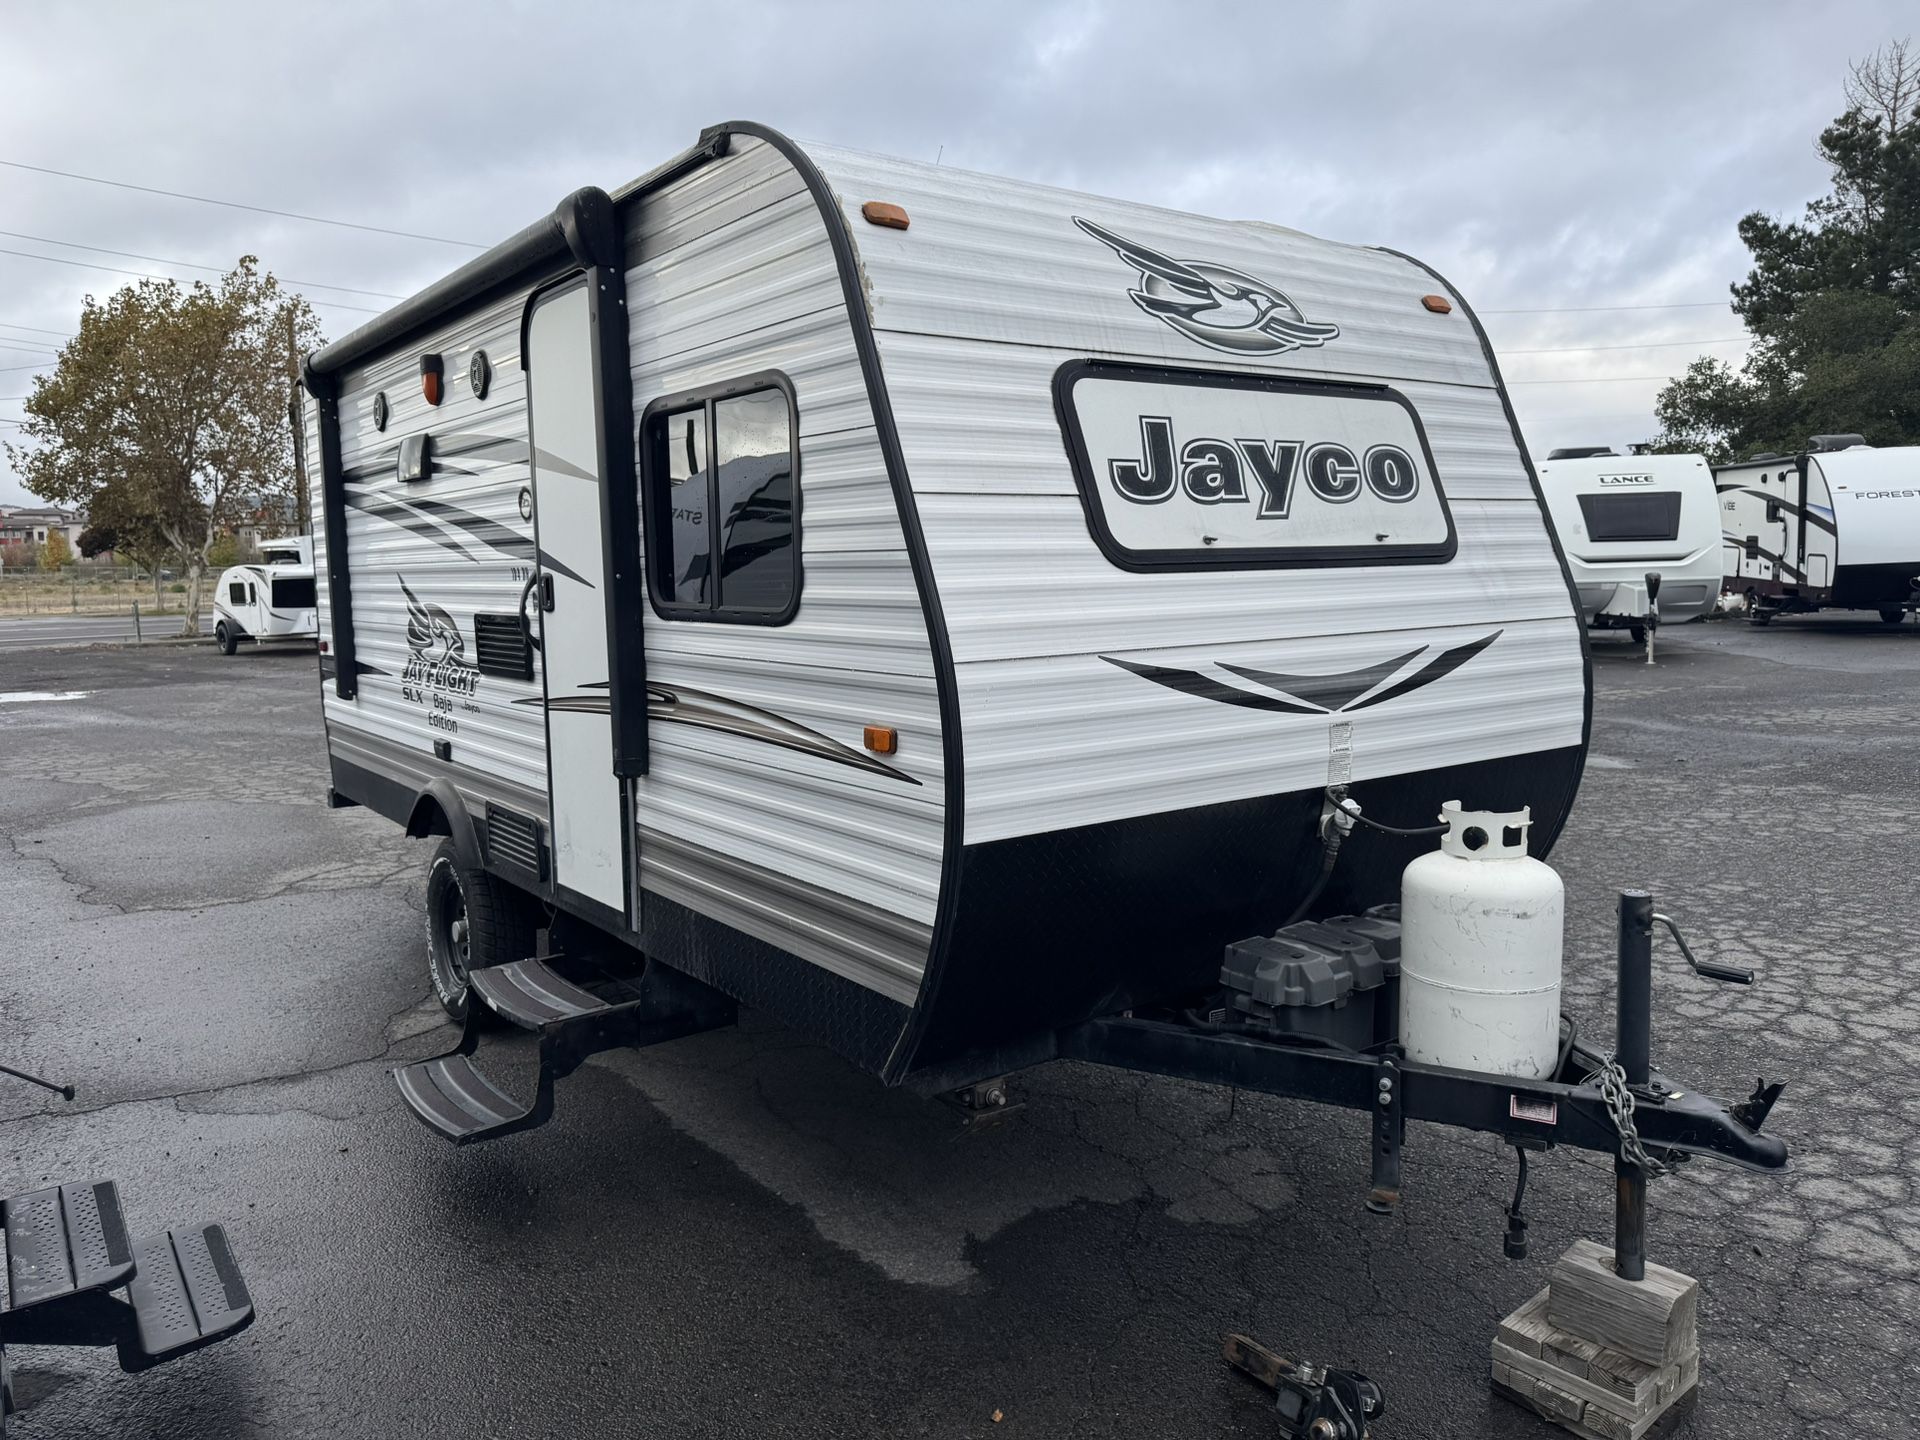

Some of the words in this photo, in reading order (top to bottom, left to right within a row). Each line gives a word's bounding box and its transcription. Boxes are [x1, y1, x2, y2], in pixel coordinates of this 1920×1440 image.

[1107, 415, 1420, 521] Jayco
[1599, 475, 1655, 484] LANCE
[401, 655, 428, 686] JAY
[425, 660, 481, 697] FLIGHT
[402, 686, 424, 704] SLX
[433, 693, 453, 714] Baja
[428, 711, 458, 733] Edition
